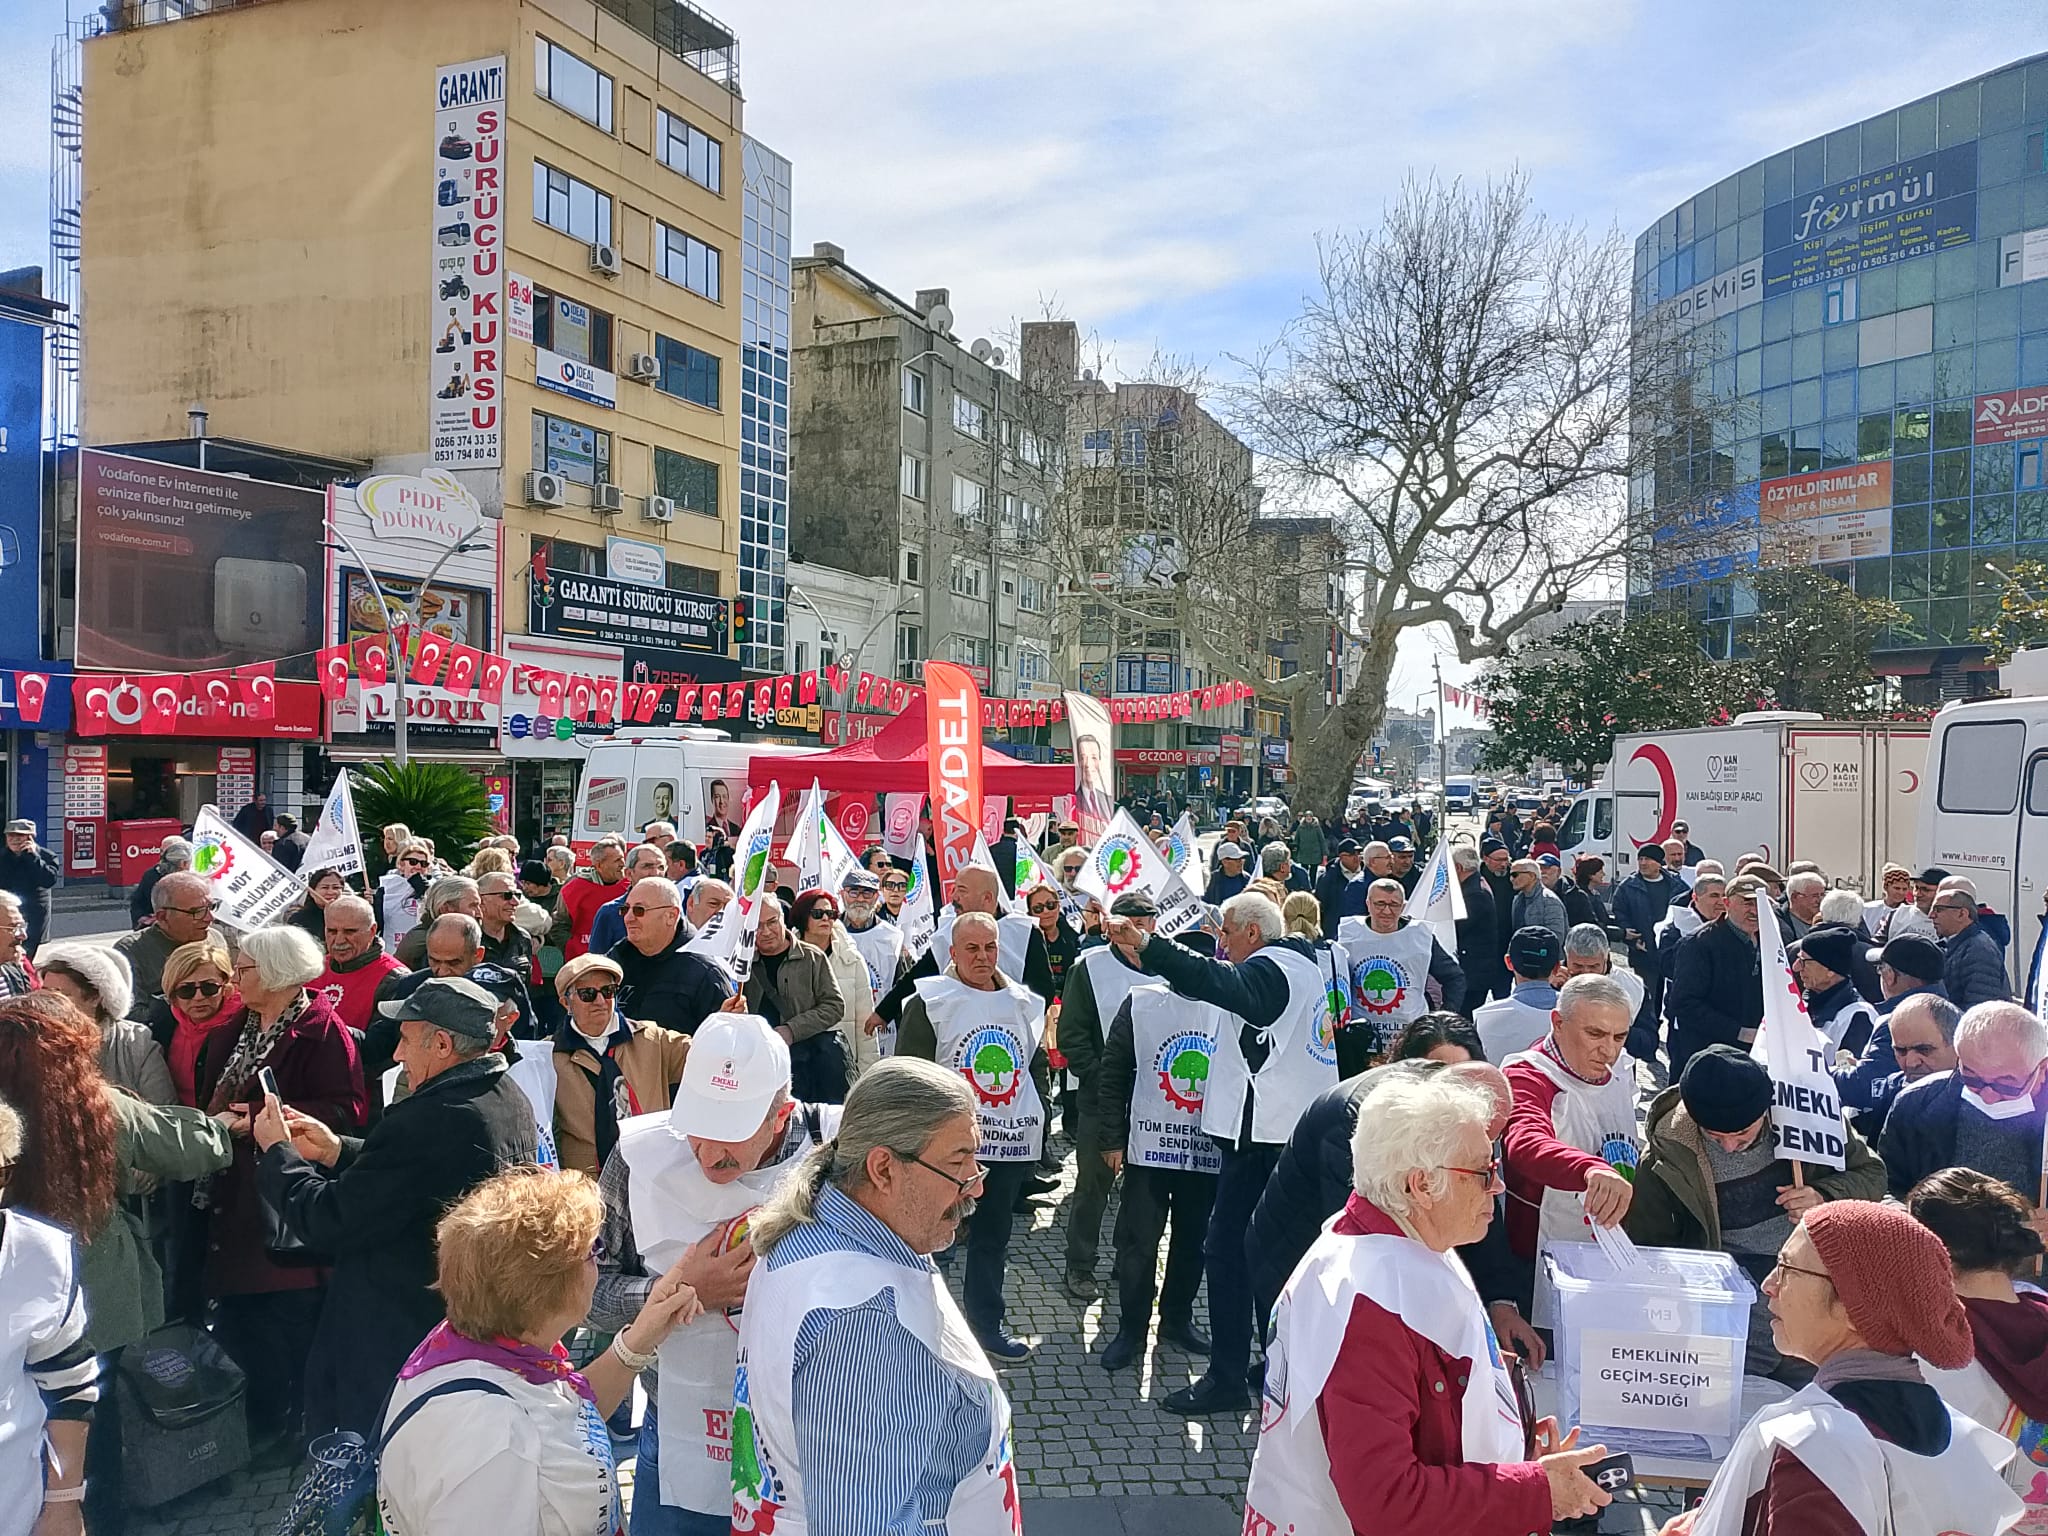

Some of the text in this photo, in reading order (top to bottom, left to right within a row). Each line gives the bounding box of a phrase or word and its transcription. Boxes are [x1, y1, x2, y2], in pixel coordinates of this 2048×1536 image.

[473, 110, 499, 276] SÜRÜCÜ
[472, 292, 498, 429] KURSU
[435, 434, 497, 448] 0266 374 33 35
[435, 448, 497, 462] 0531 794 80 43
[98, 465, 239, 500] Vodafone Ev İnterneti ile
[1767, 472, 1878, 502] ÖZYILDIRIMLAR
[97, 486, 252, 521] evinize fiber hızı getirmeye
[399, 487, 447, 514] PİDE
[97, 504, 185, 527] çok yakınsınız!
[382, 508, 463, 541] DÜNYASI
[99, 531, 171, 548] vodafone.com.tr
[559, 579, 714, 621] GARANTİ SÜRÜCÜ KURSU
[777, 709, 801, 725] GSM
[1138, 751, 1183, 762] eczane
[1724, 755, 1738, 765] KAN
[1833, 763, 1858, 773] KAN
[1833, 773, 1859, 781] BAĞIŞI
[1686, 789, 1763, 804] KAN BAĞIŞI EKİP ARACI
[1942, 852, 2006, 866] www.kanver.org
[1138, 1119, 1162, 1133] TÜM
[979, 1129, 1025, 1142] ENDİKASI
[1000, 1143, 1031, 1158] ŞUBESİ
[1159, 1137, 1213, 1152] SENDİKASI
[1145, 1151, 1190, 1166] EDREMİT
[1612, 1347, 1699, 1365] EMEKLİNİN
[1600, 1368, 1710, 1389] GEÇİM-SEÇİM
[1621, 1391, 1688, 1408] SANDIĞI
